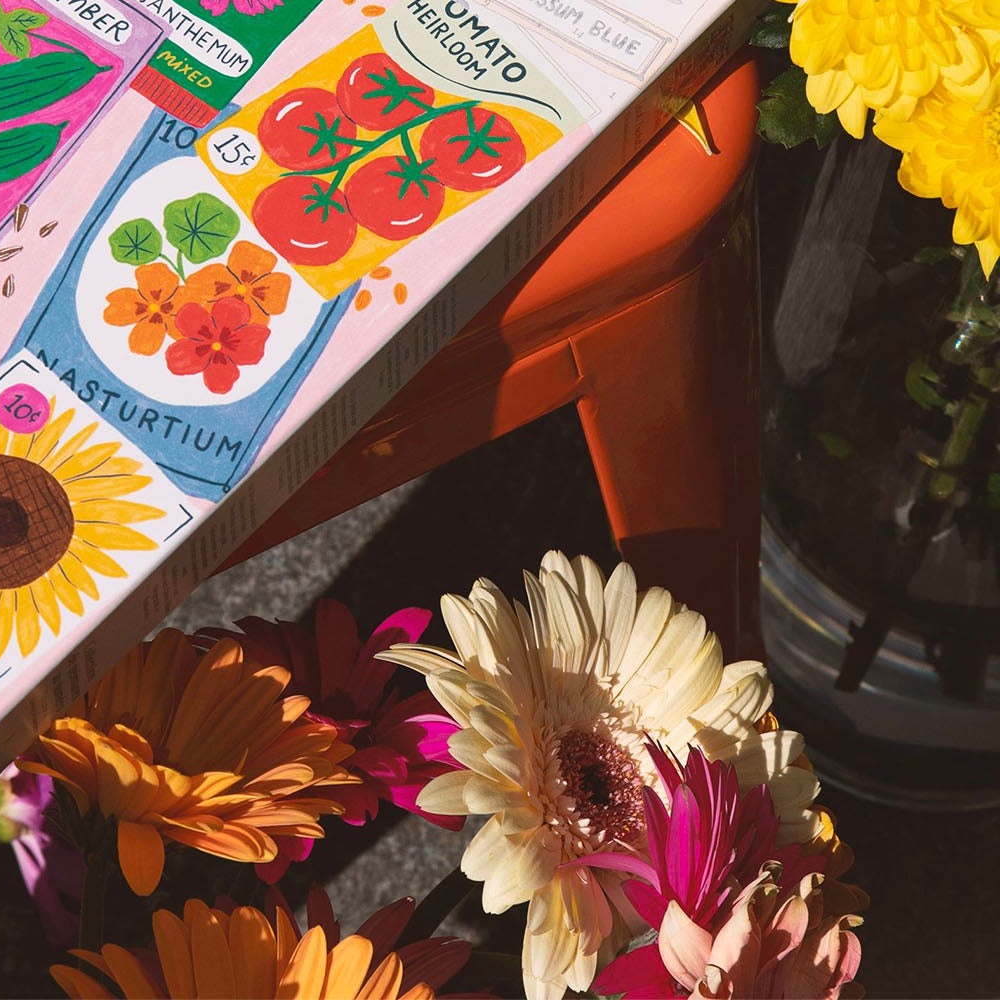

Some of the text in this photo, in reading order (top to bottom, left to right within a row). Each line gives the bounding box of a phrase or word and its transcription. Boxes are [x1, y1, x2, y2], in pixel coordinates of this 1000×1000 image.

[588, 19, 641, 55] BLUE
[213, 134, 257, 167] 15¢
[4, 394, 42, 424] 10¢
[36, 349, 243, 462] NASTURTIUM
